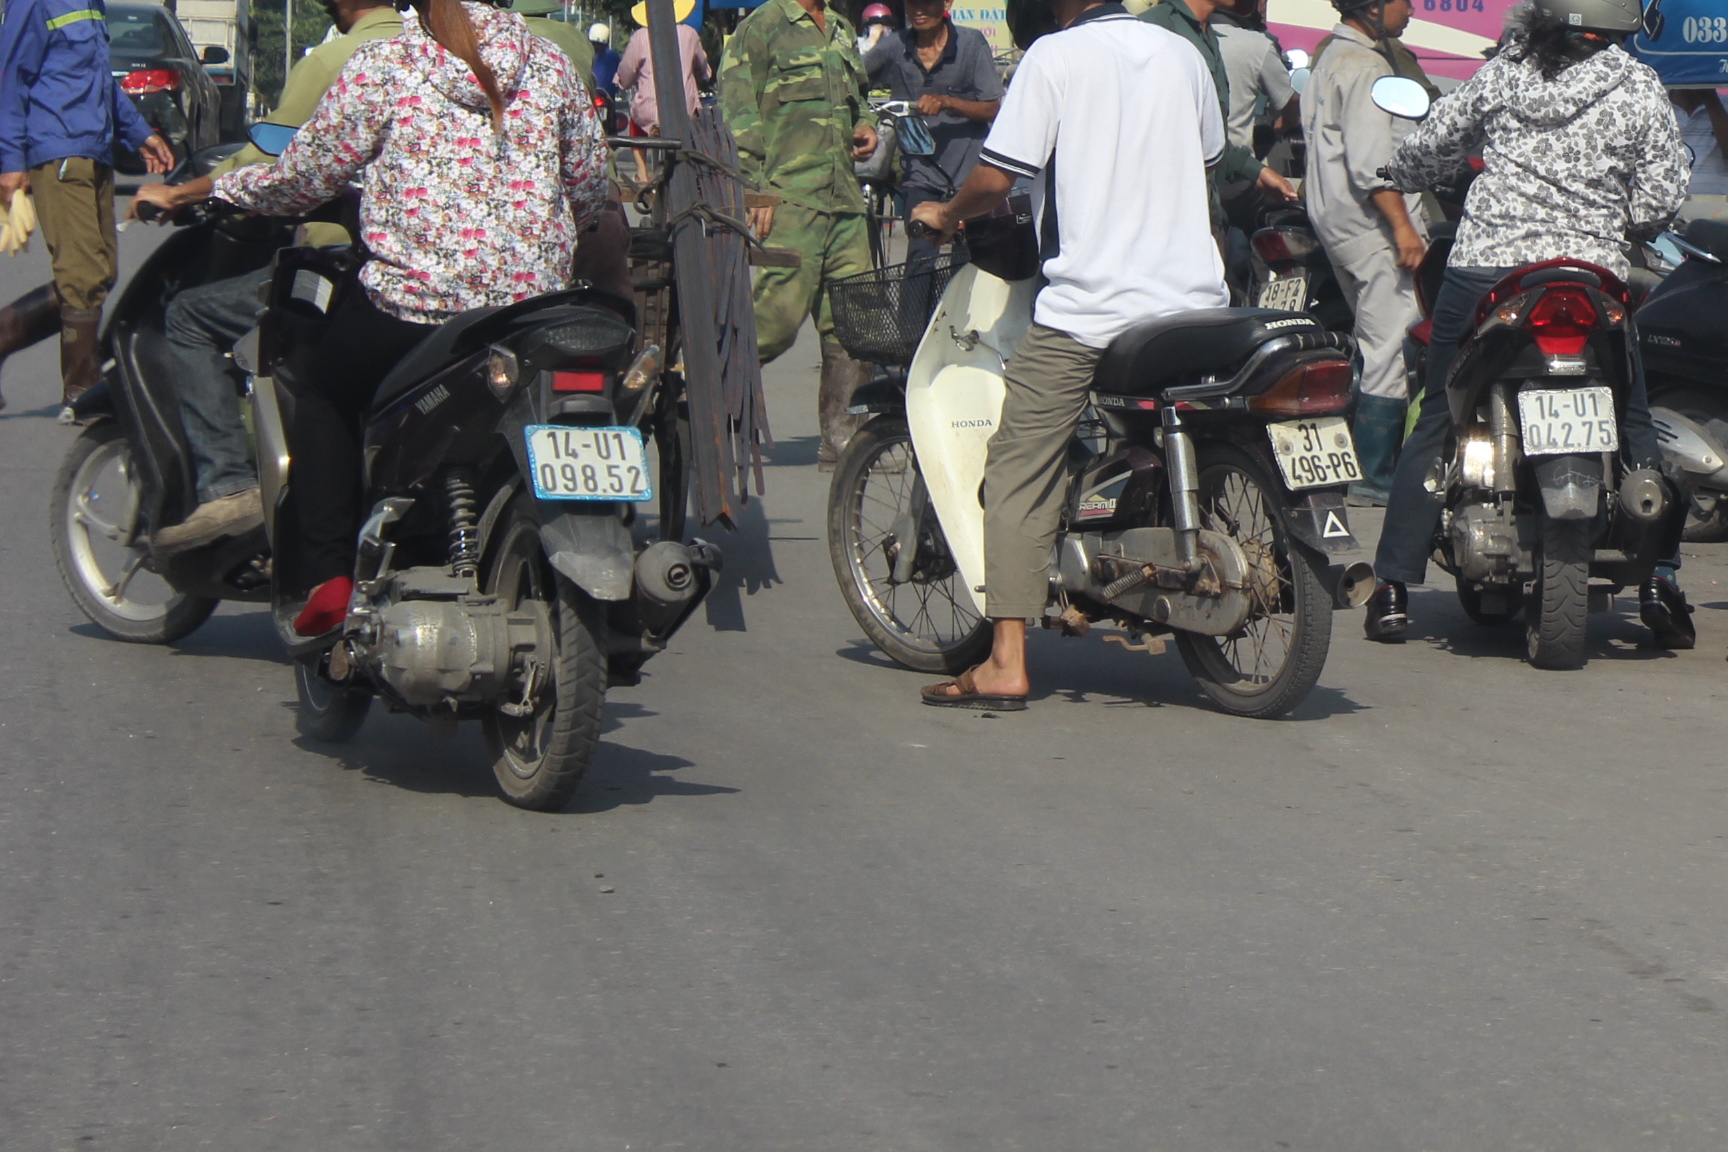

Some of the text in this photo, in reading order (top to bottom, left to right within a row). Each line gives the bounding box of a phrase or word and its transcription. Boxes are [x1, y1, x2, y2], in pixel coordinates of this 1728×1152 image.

[1265, 318, 1315, 330] HONDA
[415, 384, 450, 415] YAMAHA
[1098, 396, 1125, 408] HONDA
[1535, 393, 1600, 420] 14-U1
[951, 419, 993, 428] HONDA
[1298, 422, 1324, 452] 31
[1529, 420, 1612, 449] 042.75
[547, 432, 626, 461] 14-U1
[540, 464, 644, 495] 098.52
[1291, 452, 1358, 485] 496-P6
[1078, 501, 1109, 511] REAM
